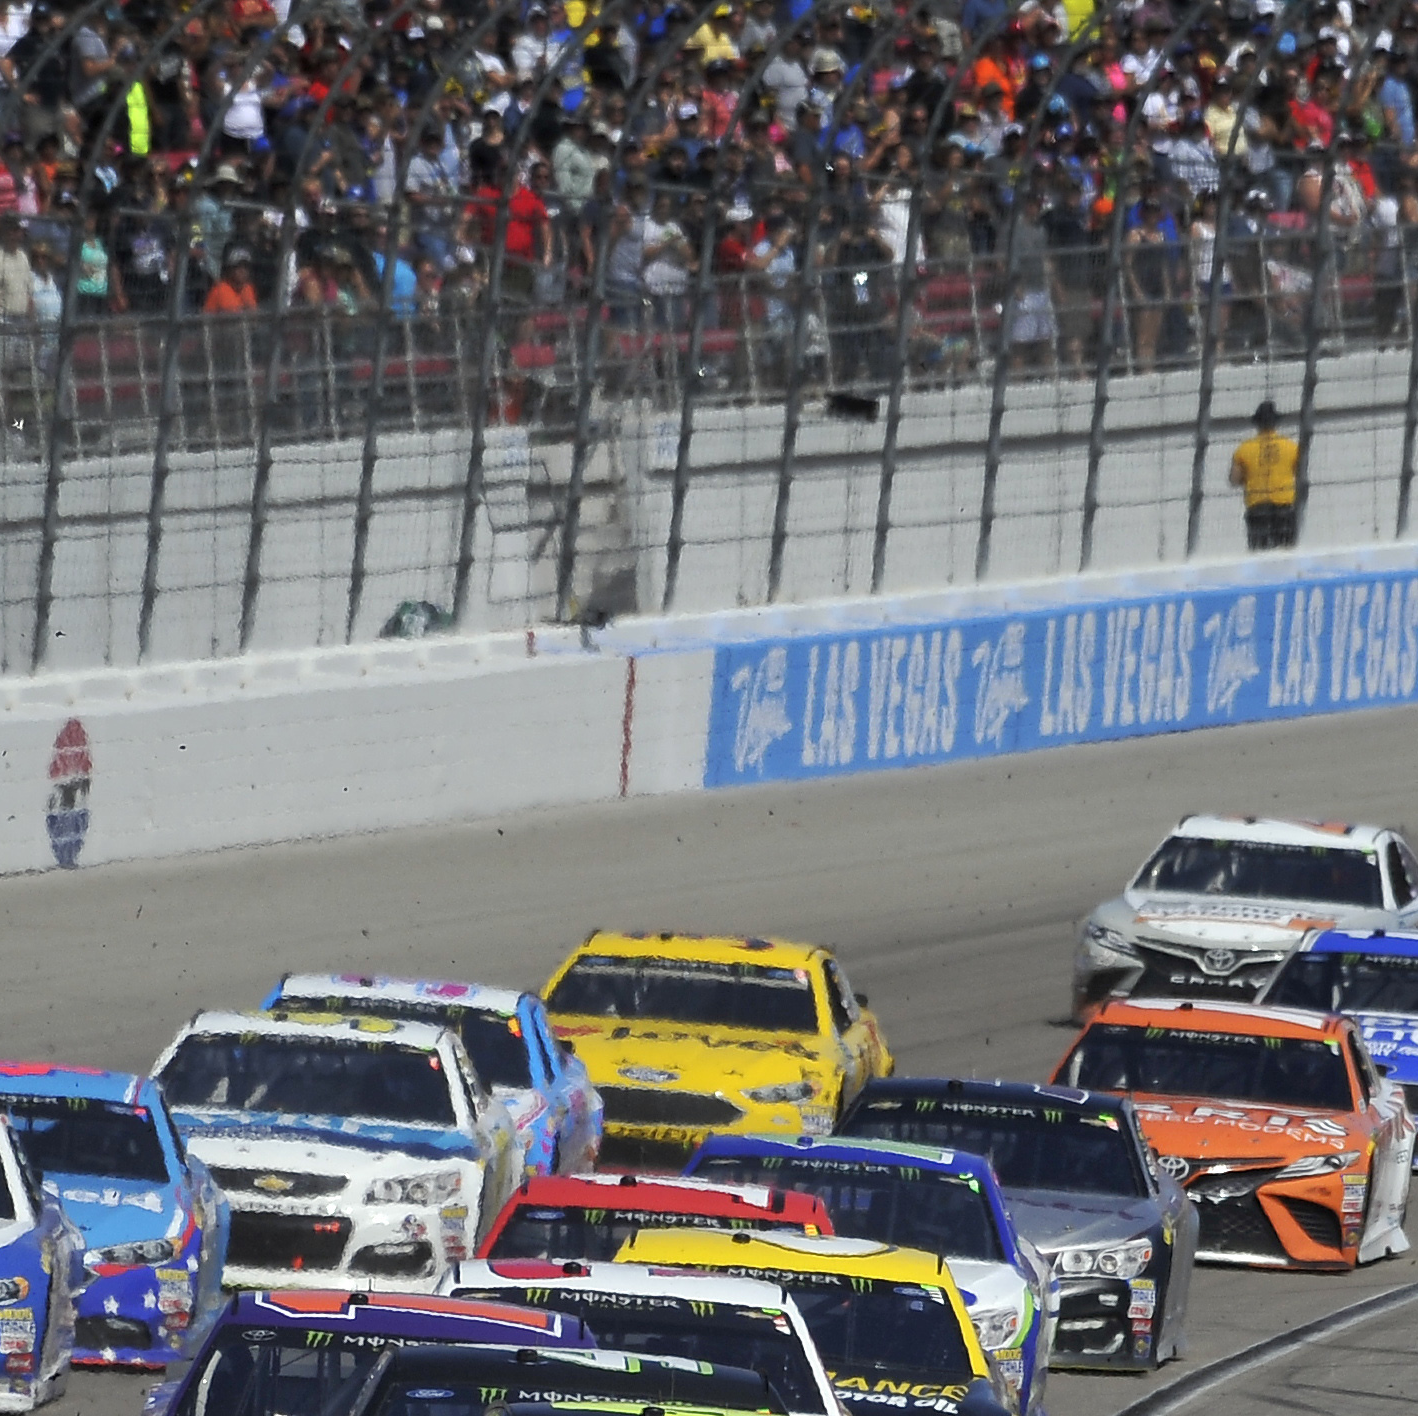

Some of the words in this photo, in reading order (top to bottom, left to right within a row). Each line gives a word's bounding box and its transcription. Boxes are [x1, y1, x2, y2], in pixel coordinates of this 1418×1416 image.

[1268, 587, 1324, 707] LAS
[1039, 611, 1096, 735] LAS
[1102, 600, 1196, 727] VEGAS
[801, 641, 860, 766] LAS
[868, 627, 961, 760] VEGAS
[1169, 1030, 1257, 1046] MONSTER
[942, 1102, 1036, 1118] MONSTER
[1214, 1118, 1346, 1150] MODEMS
[791, 1158, 890, 1174] MONSTER
[614, 1210, 721, 1228] MONSTER
[727, 1265, 843, 1287] MONSTER
[559, 1290, 680, 1309] MONSTER
[834, 1390, 908, 1408] OTOR
[913, 1399, 959, 1415] OIL
